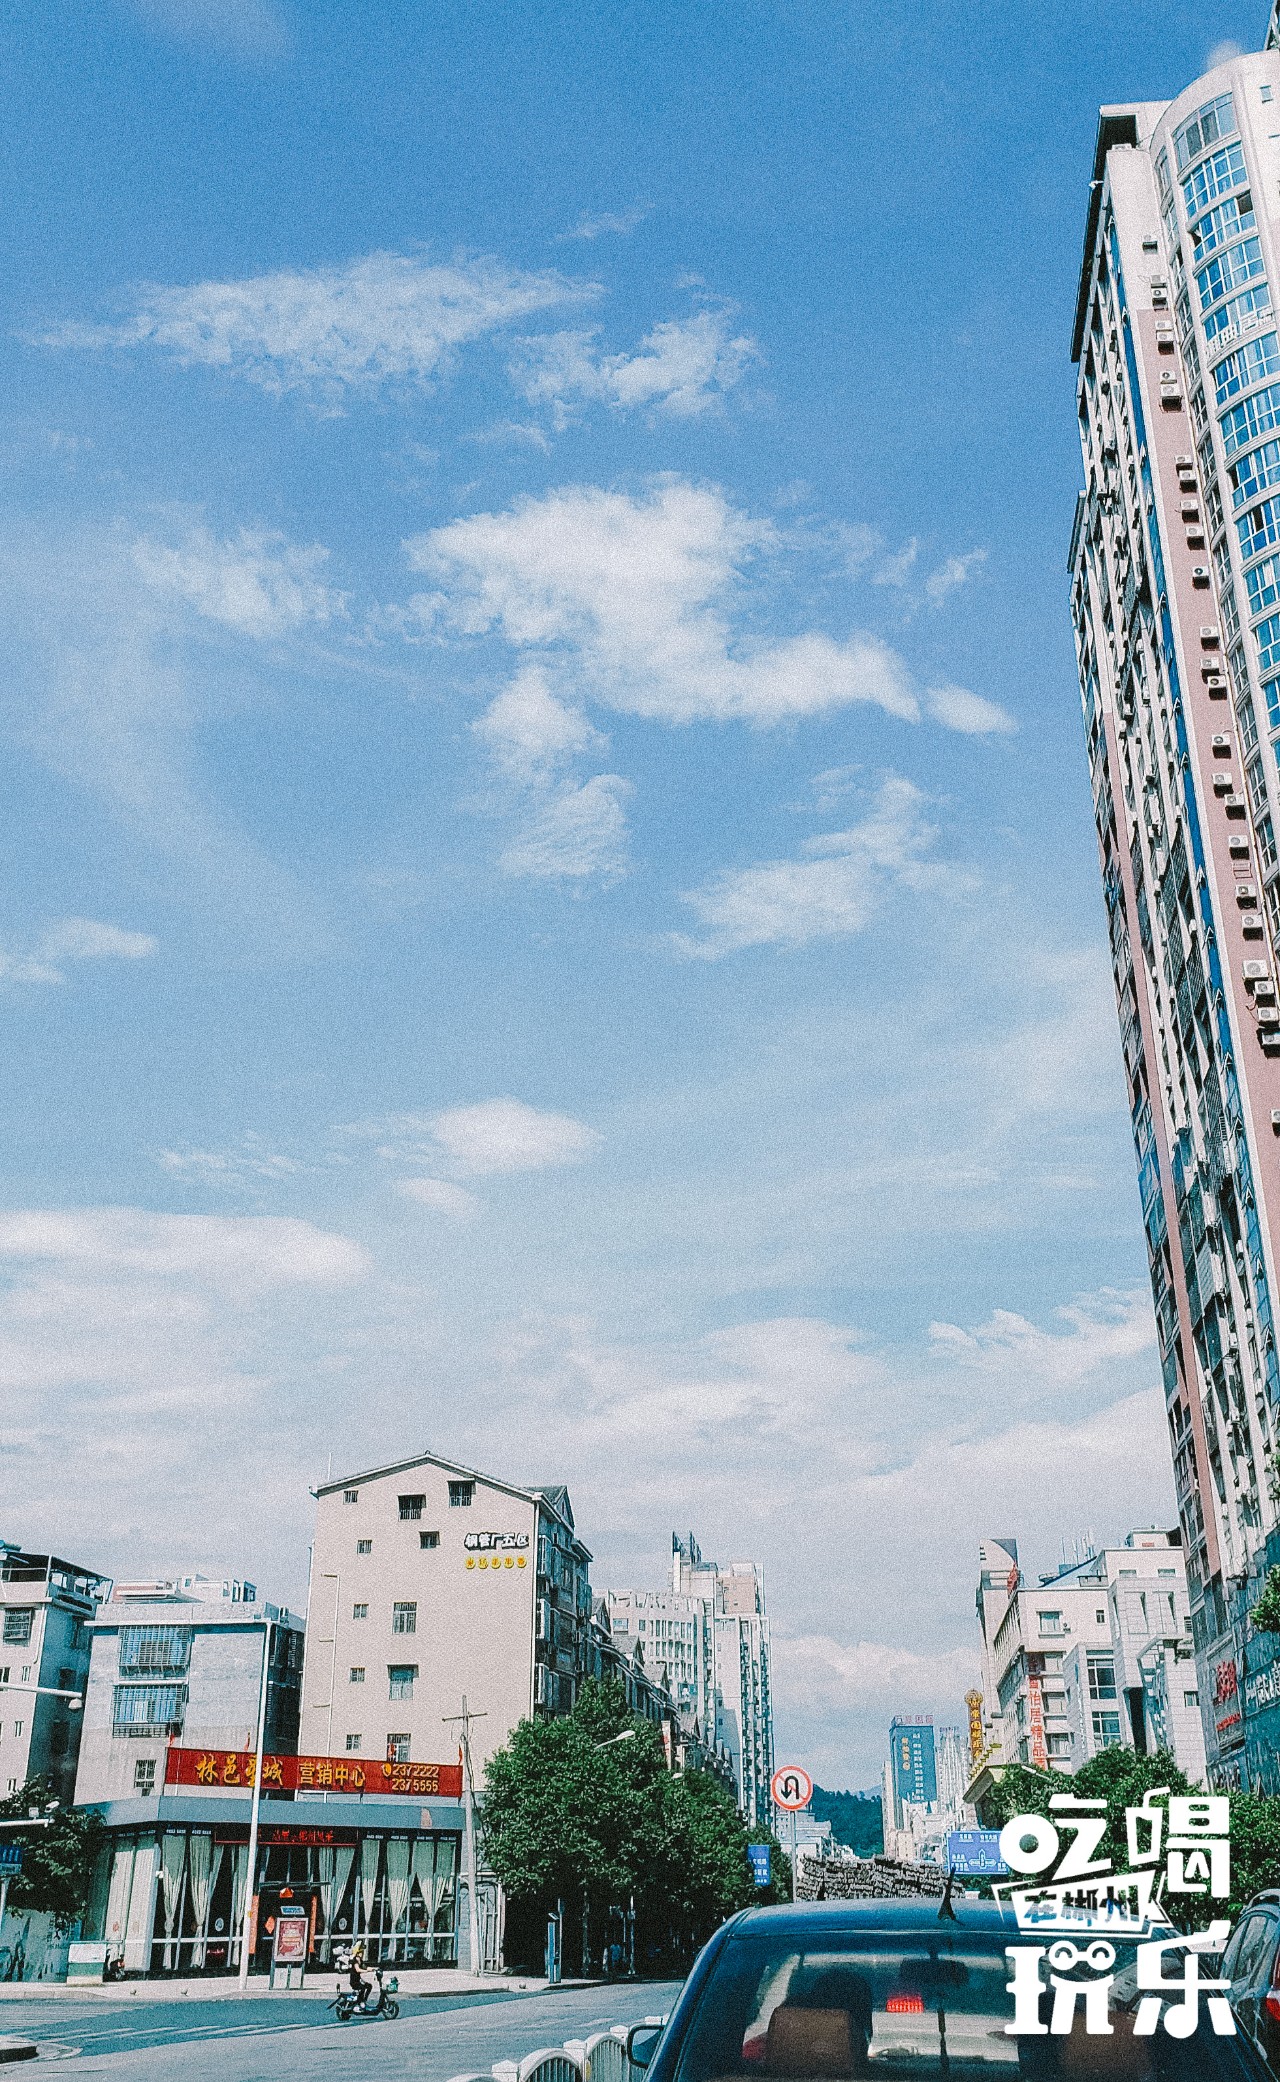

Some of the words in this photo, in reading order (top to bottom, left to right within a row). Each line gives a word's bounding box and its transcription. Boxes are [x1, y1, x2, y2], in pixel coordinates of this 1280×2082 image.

[299, 1762, 366, 1787] 营销中心
[392, 1763, 439, 1778] 2372222
[391, 1778, 439, 1793] 2375555
